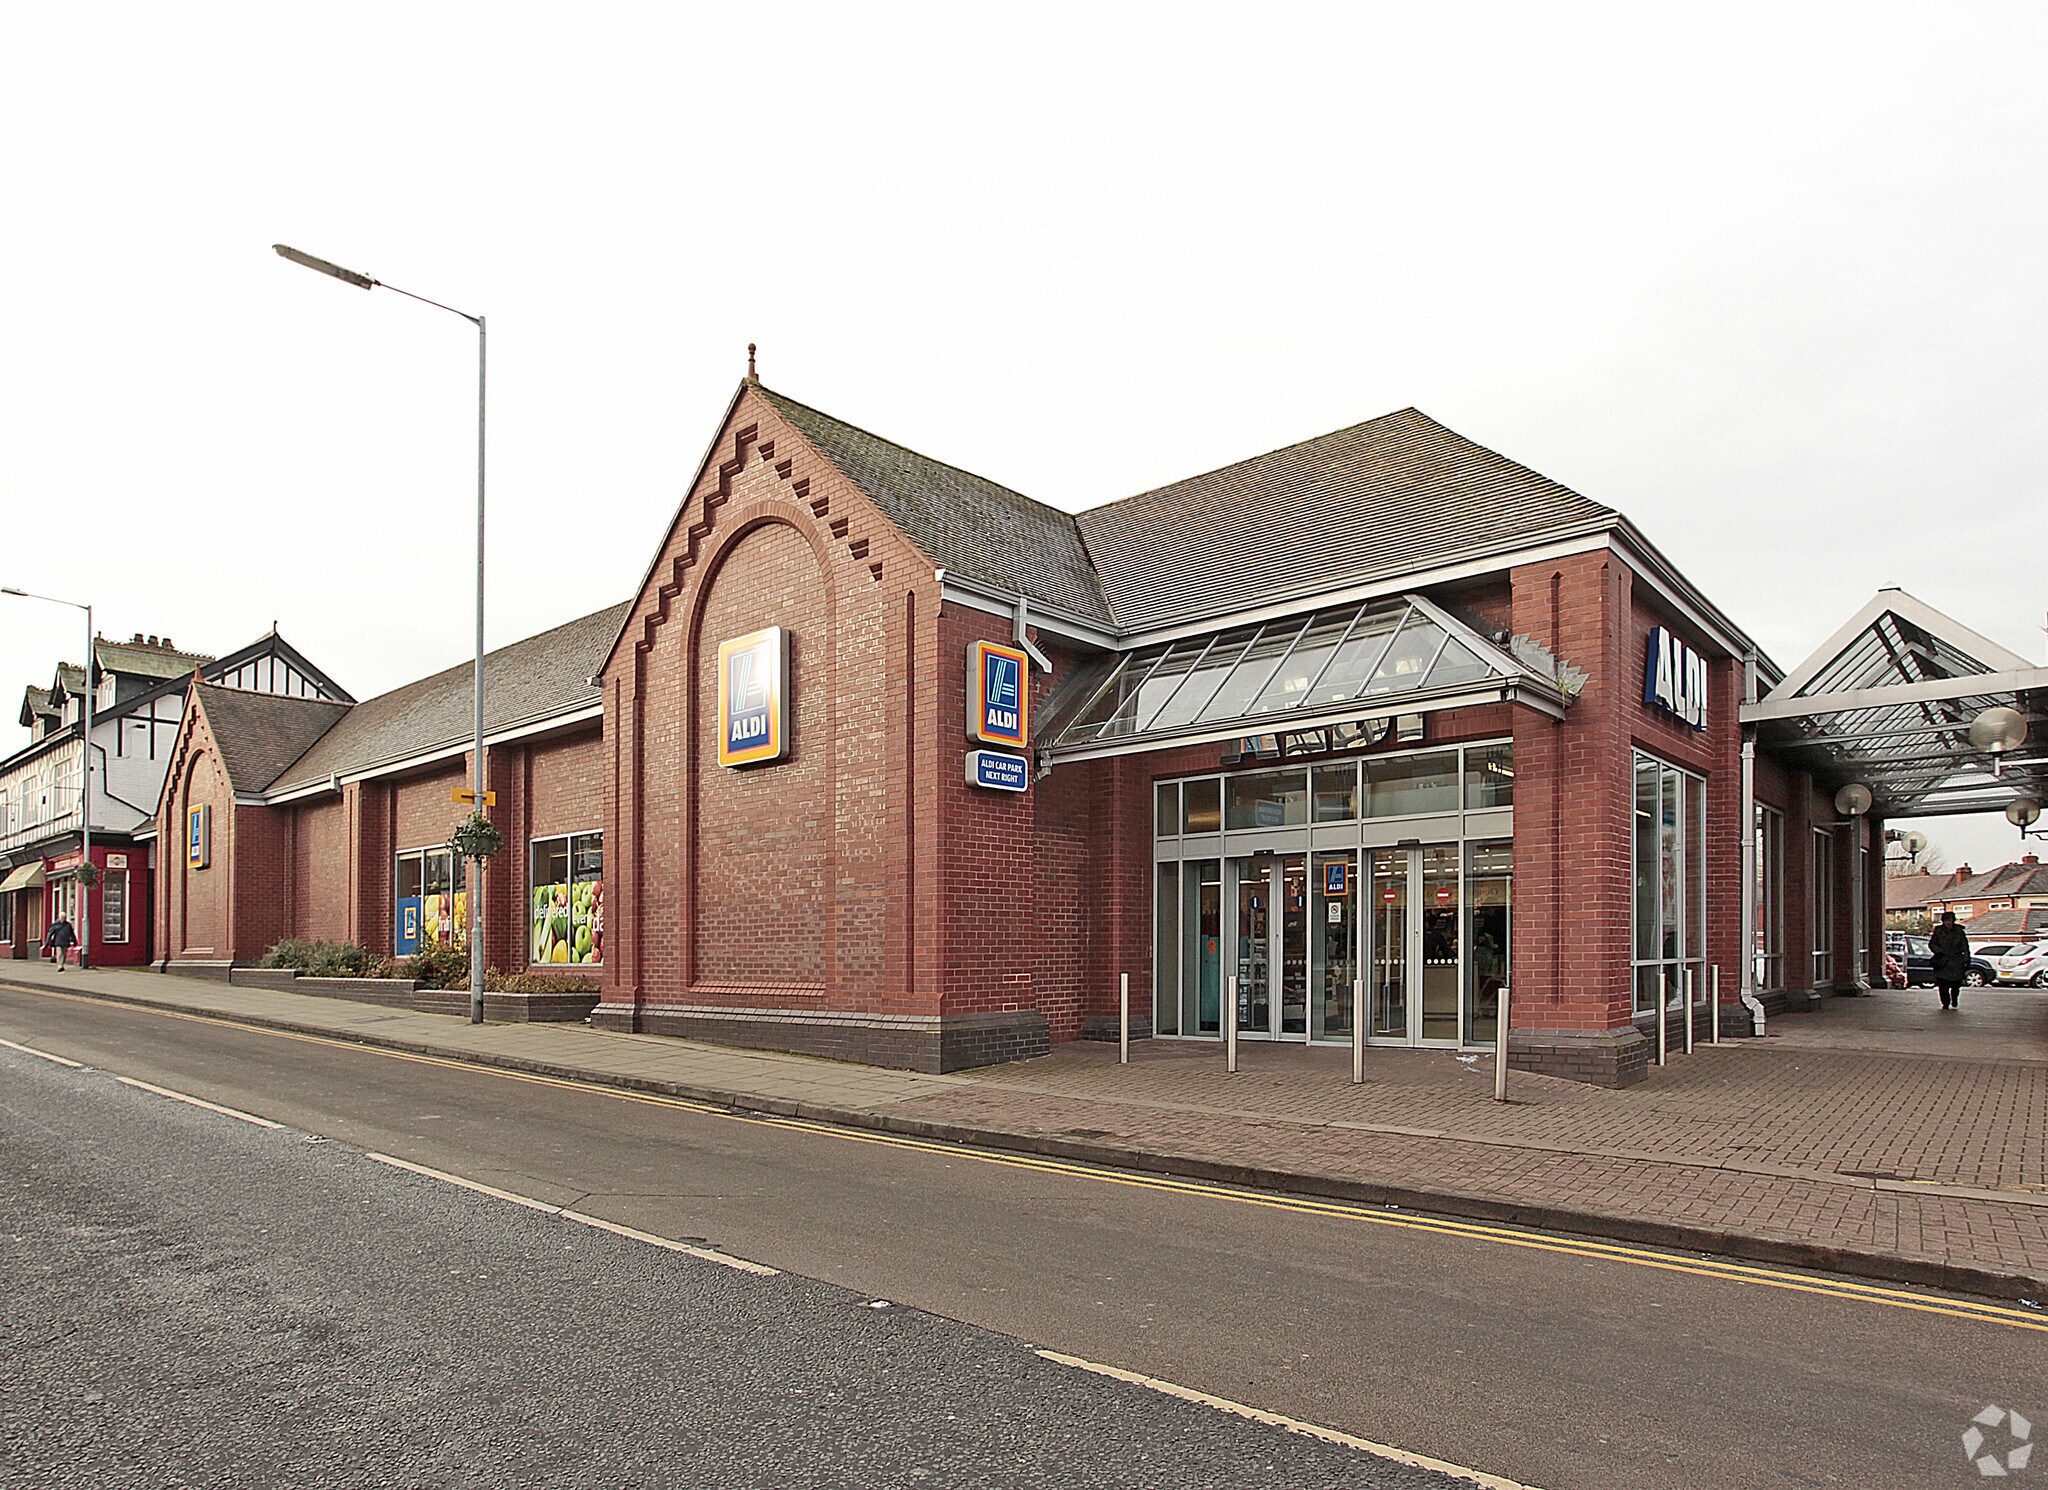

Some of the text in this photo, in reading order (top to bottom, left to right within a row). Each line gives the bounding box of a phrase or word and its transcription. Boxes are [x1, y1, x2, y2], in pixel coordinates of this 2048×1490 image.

[1654, 625, 1708, 732] ALDI
[731, 714, 766, 742] ALDI
[987, 708, 1018, 730] ALDI
[981, 759, 1023, 774] ALDI CAR PARK
[985, 770, 1018, 784] NEXT RIGHT
[1328, 883, 1343, 891] ALDI
